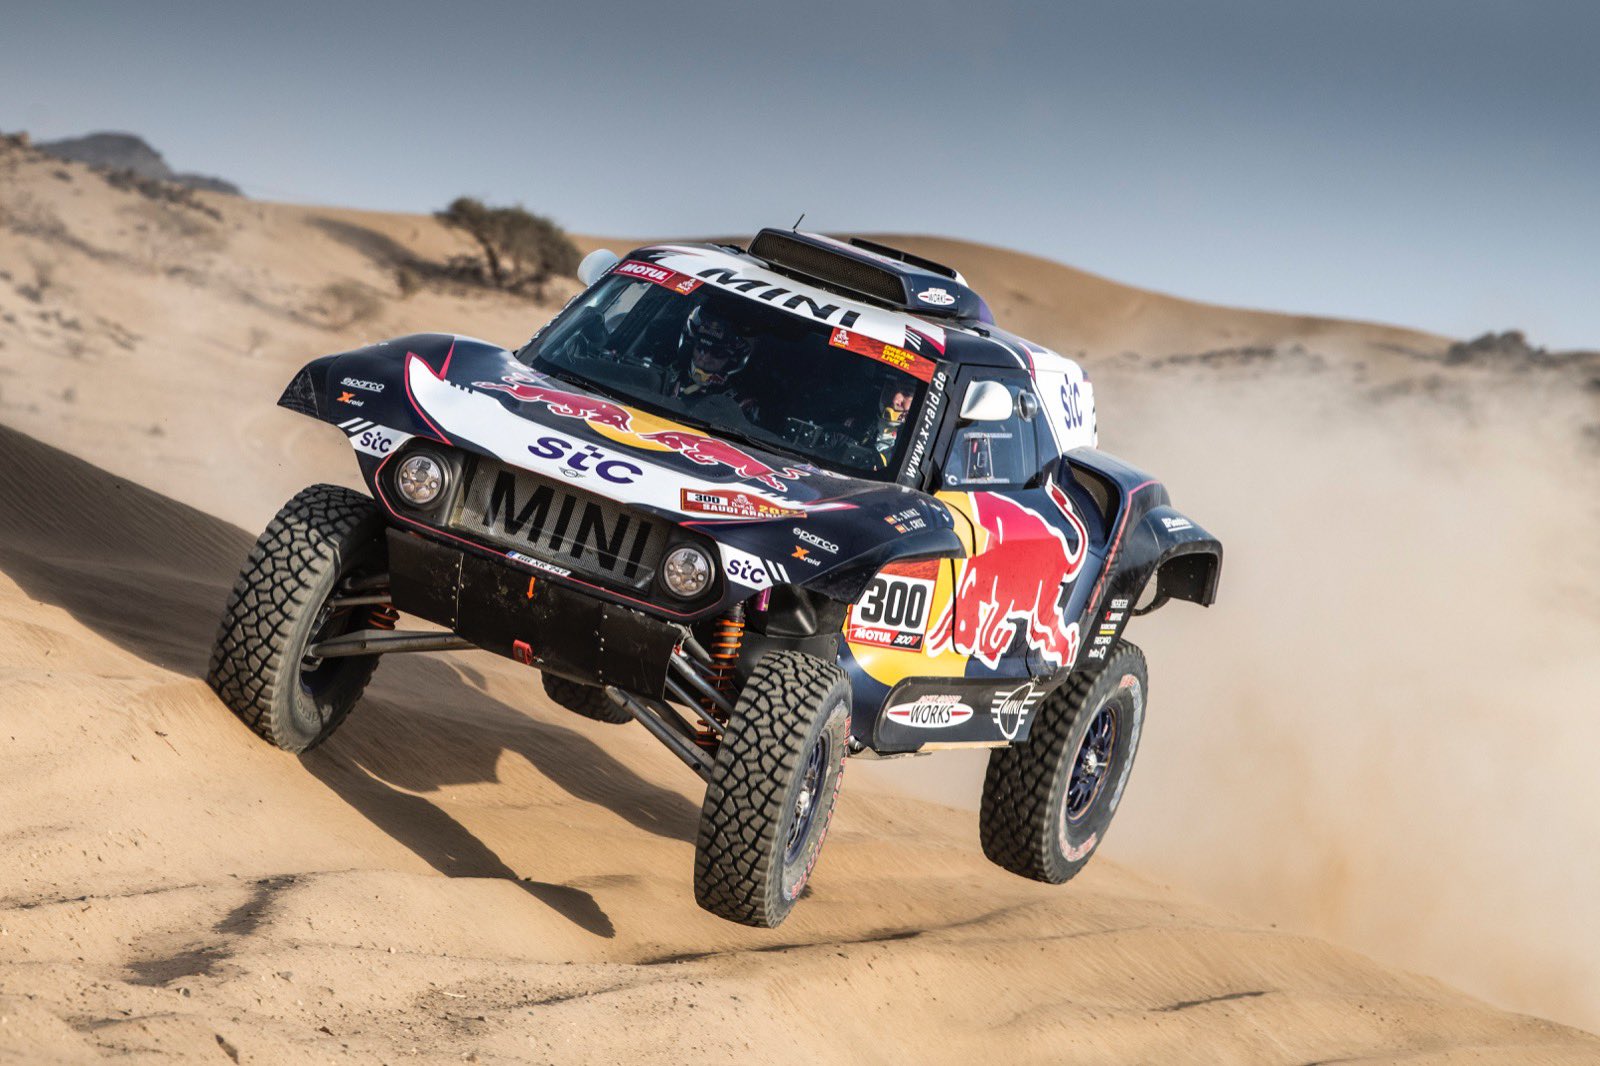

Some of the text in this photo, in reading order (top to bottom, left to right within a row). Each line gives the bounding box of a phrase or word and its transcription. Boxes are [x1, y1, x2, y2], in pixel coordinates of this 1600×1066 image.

[619, 263, 669, 281] MOTUL
[696, 268, 861, 329] MINI
[906, 371, 947, 479] www.x-raid.de
[695, 493, 721, 504] 300
[702, 503, 739, 515] SAUDI
[482, 470, 653, 579] MINI
[792, 527, 840, 554] sparco
[860, 577, 928, 630] 300
[854, 628, 892, 643] MOTUL
[910, 704, 955, 724] WORKS
[1000, 700, 1023, 715] MINI
